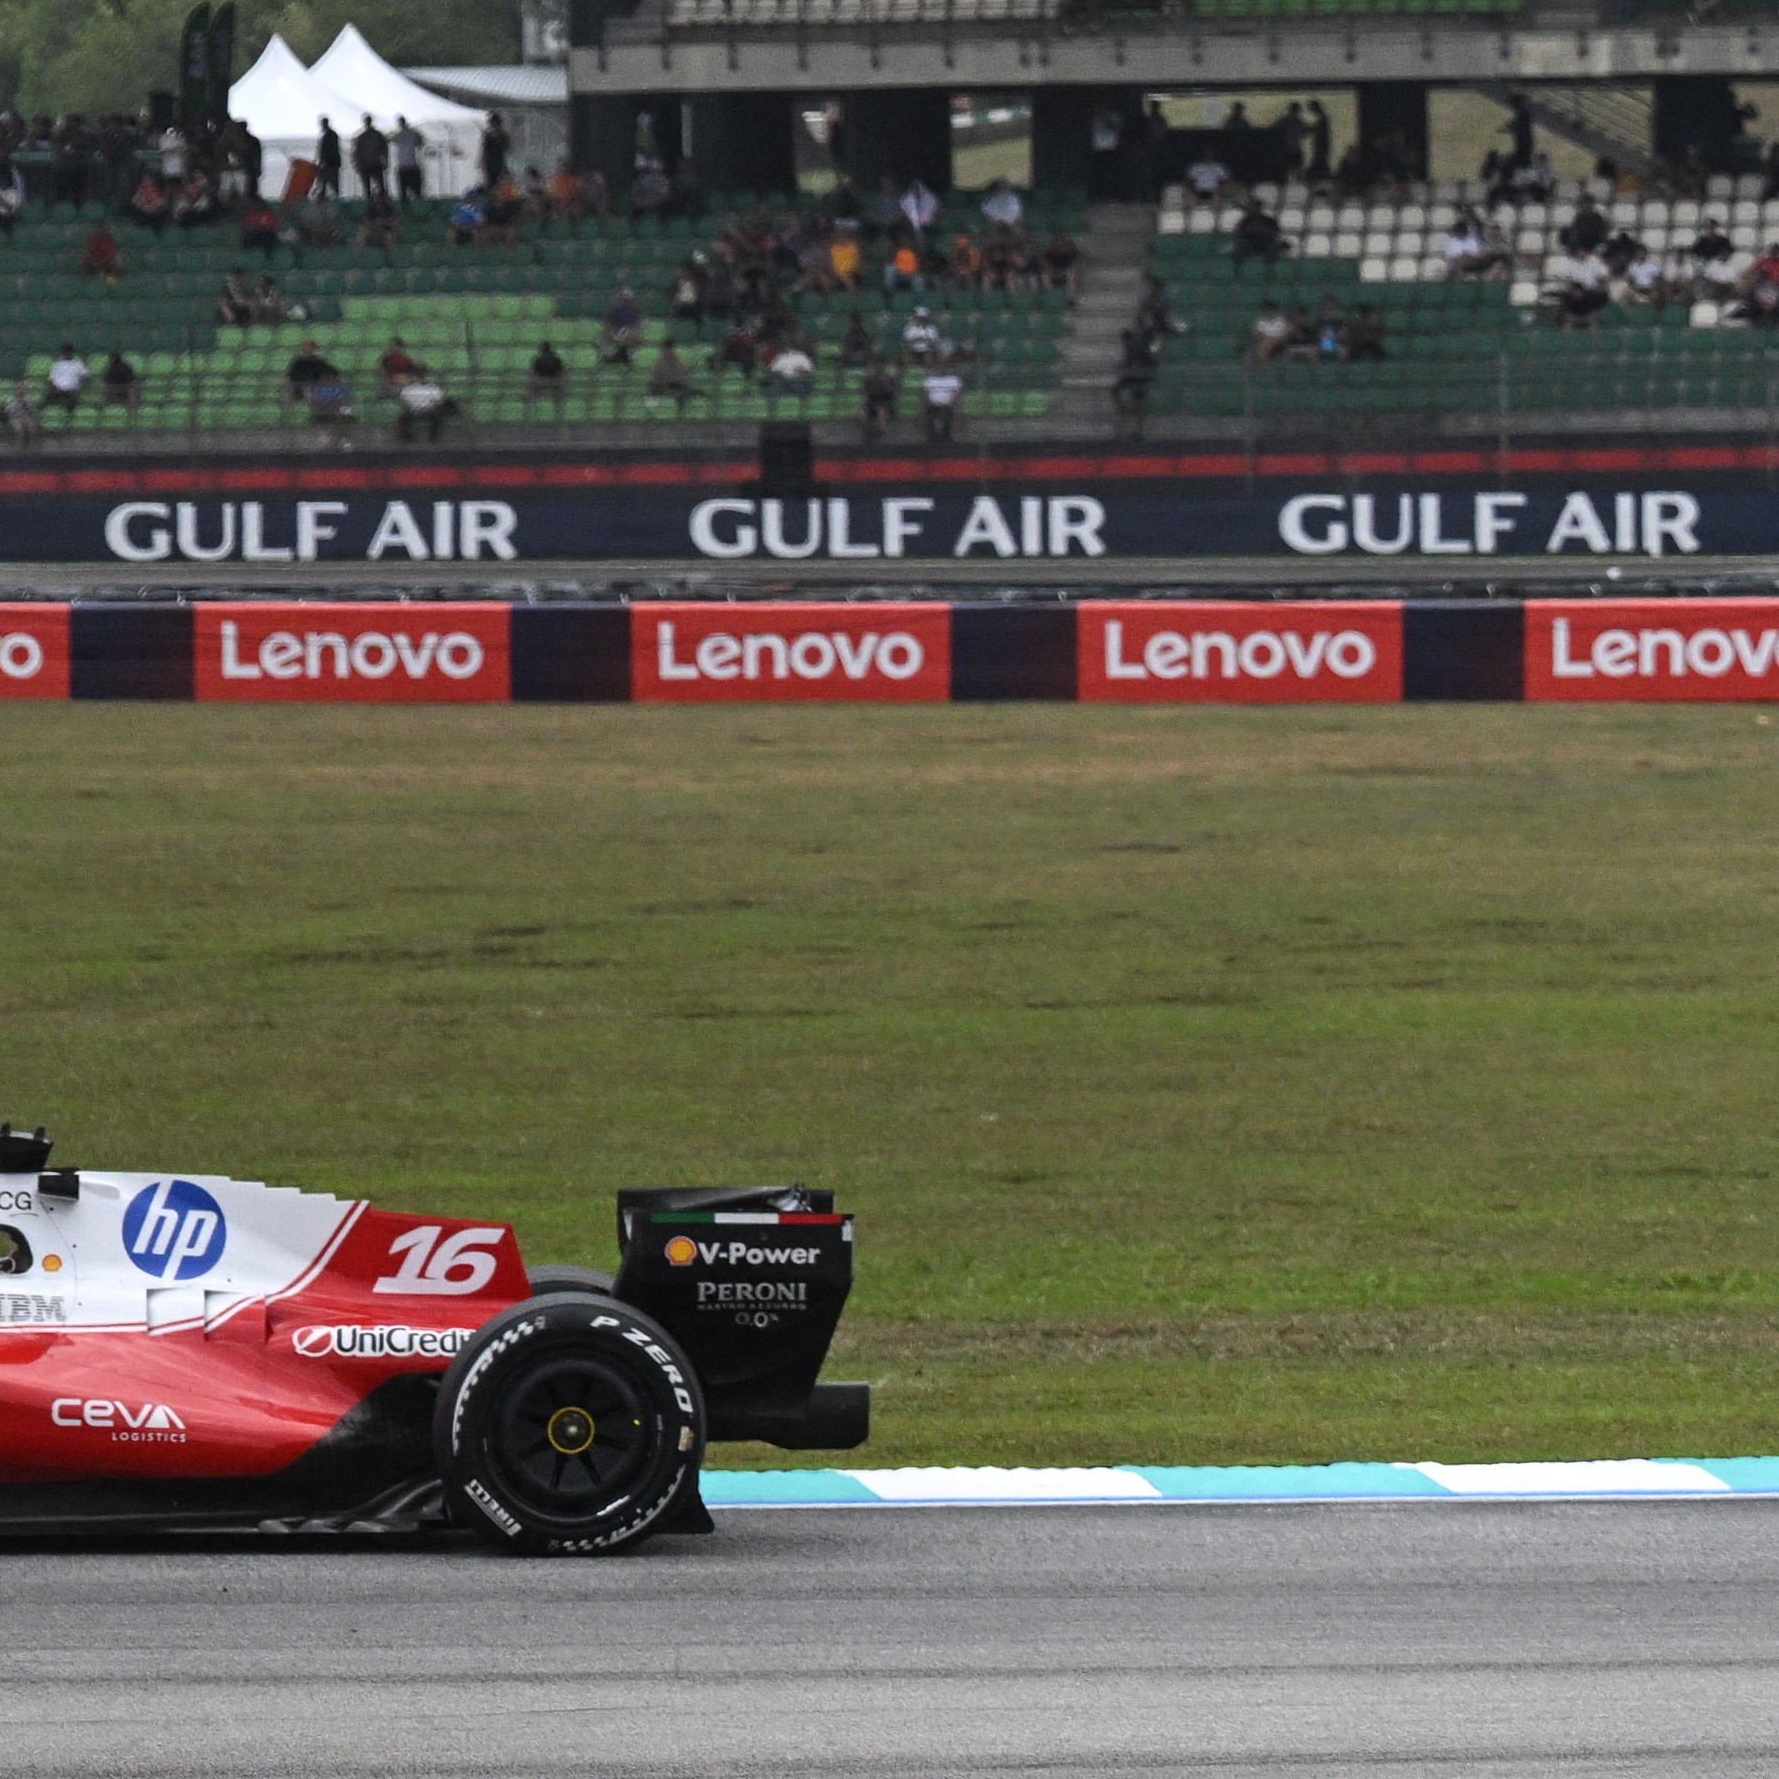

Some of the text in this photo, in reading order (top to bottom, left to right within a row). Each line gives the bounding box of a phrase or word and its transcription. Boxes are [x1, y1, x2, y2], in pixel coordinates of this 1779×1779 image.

[104, 500, 518, 562] GULF AIR
[689, 496, 1106, 558] GULF AIR
[1278, 491, 1700, 558] GULF AIR
[222, 618, 482, 678] Lenovo
[659, 618, 922, 679] Lenovo
[1106, 618, 1374, 678] Lenovo
[1553, 618, 1779, 677] Lenov
[133, 1180, 218, 1280] hp
[372, 1224, 506, 1295] 16
[698, 1242, 820, 1265] V-Power
[697, 1281, 807, 1302] PERONI
[336, 1325, 475, 1356] UniCredi
[590, 1315, 694, 1413] P ZERO
[111, 1431, 187, 1444] LOGISTICS
[464, 1478, 523, 1537] PIRELLI
